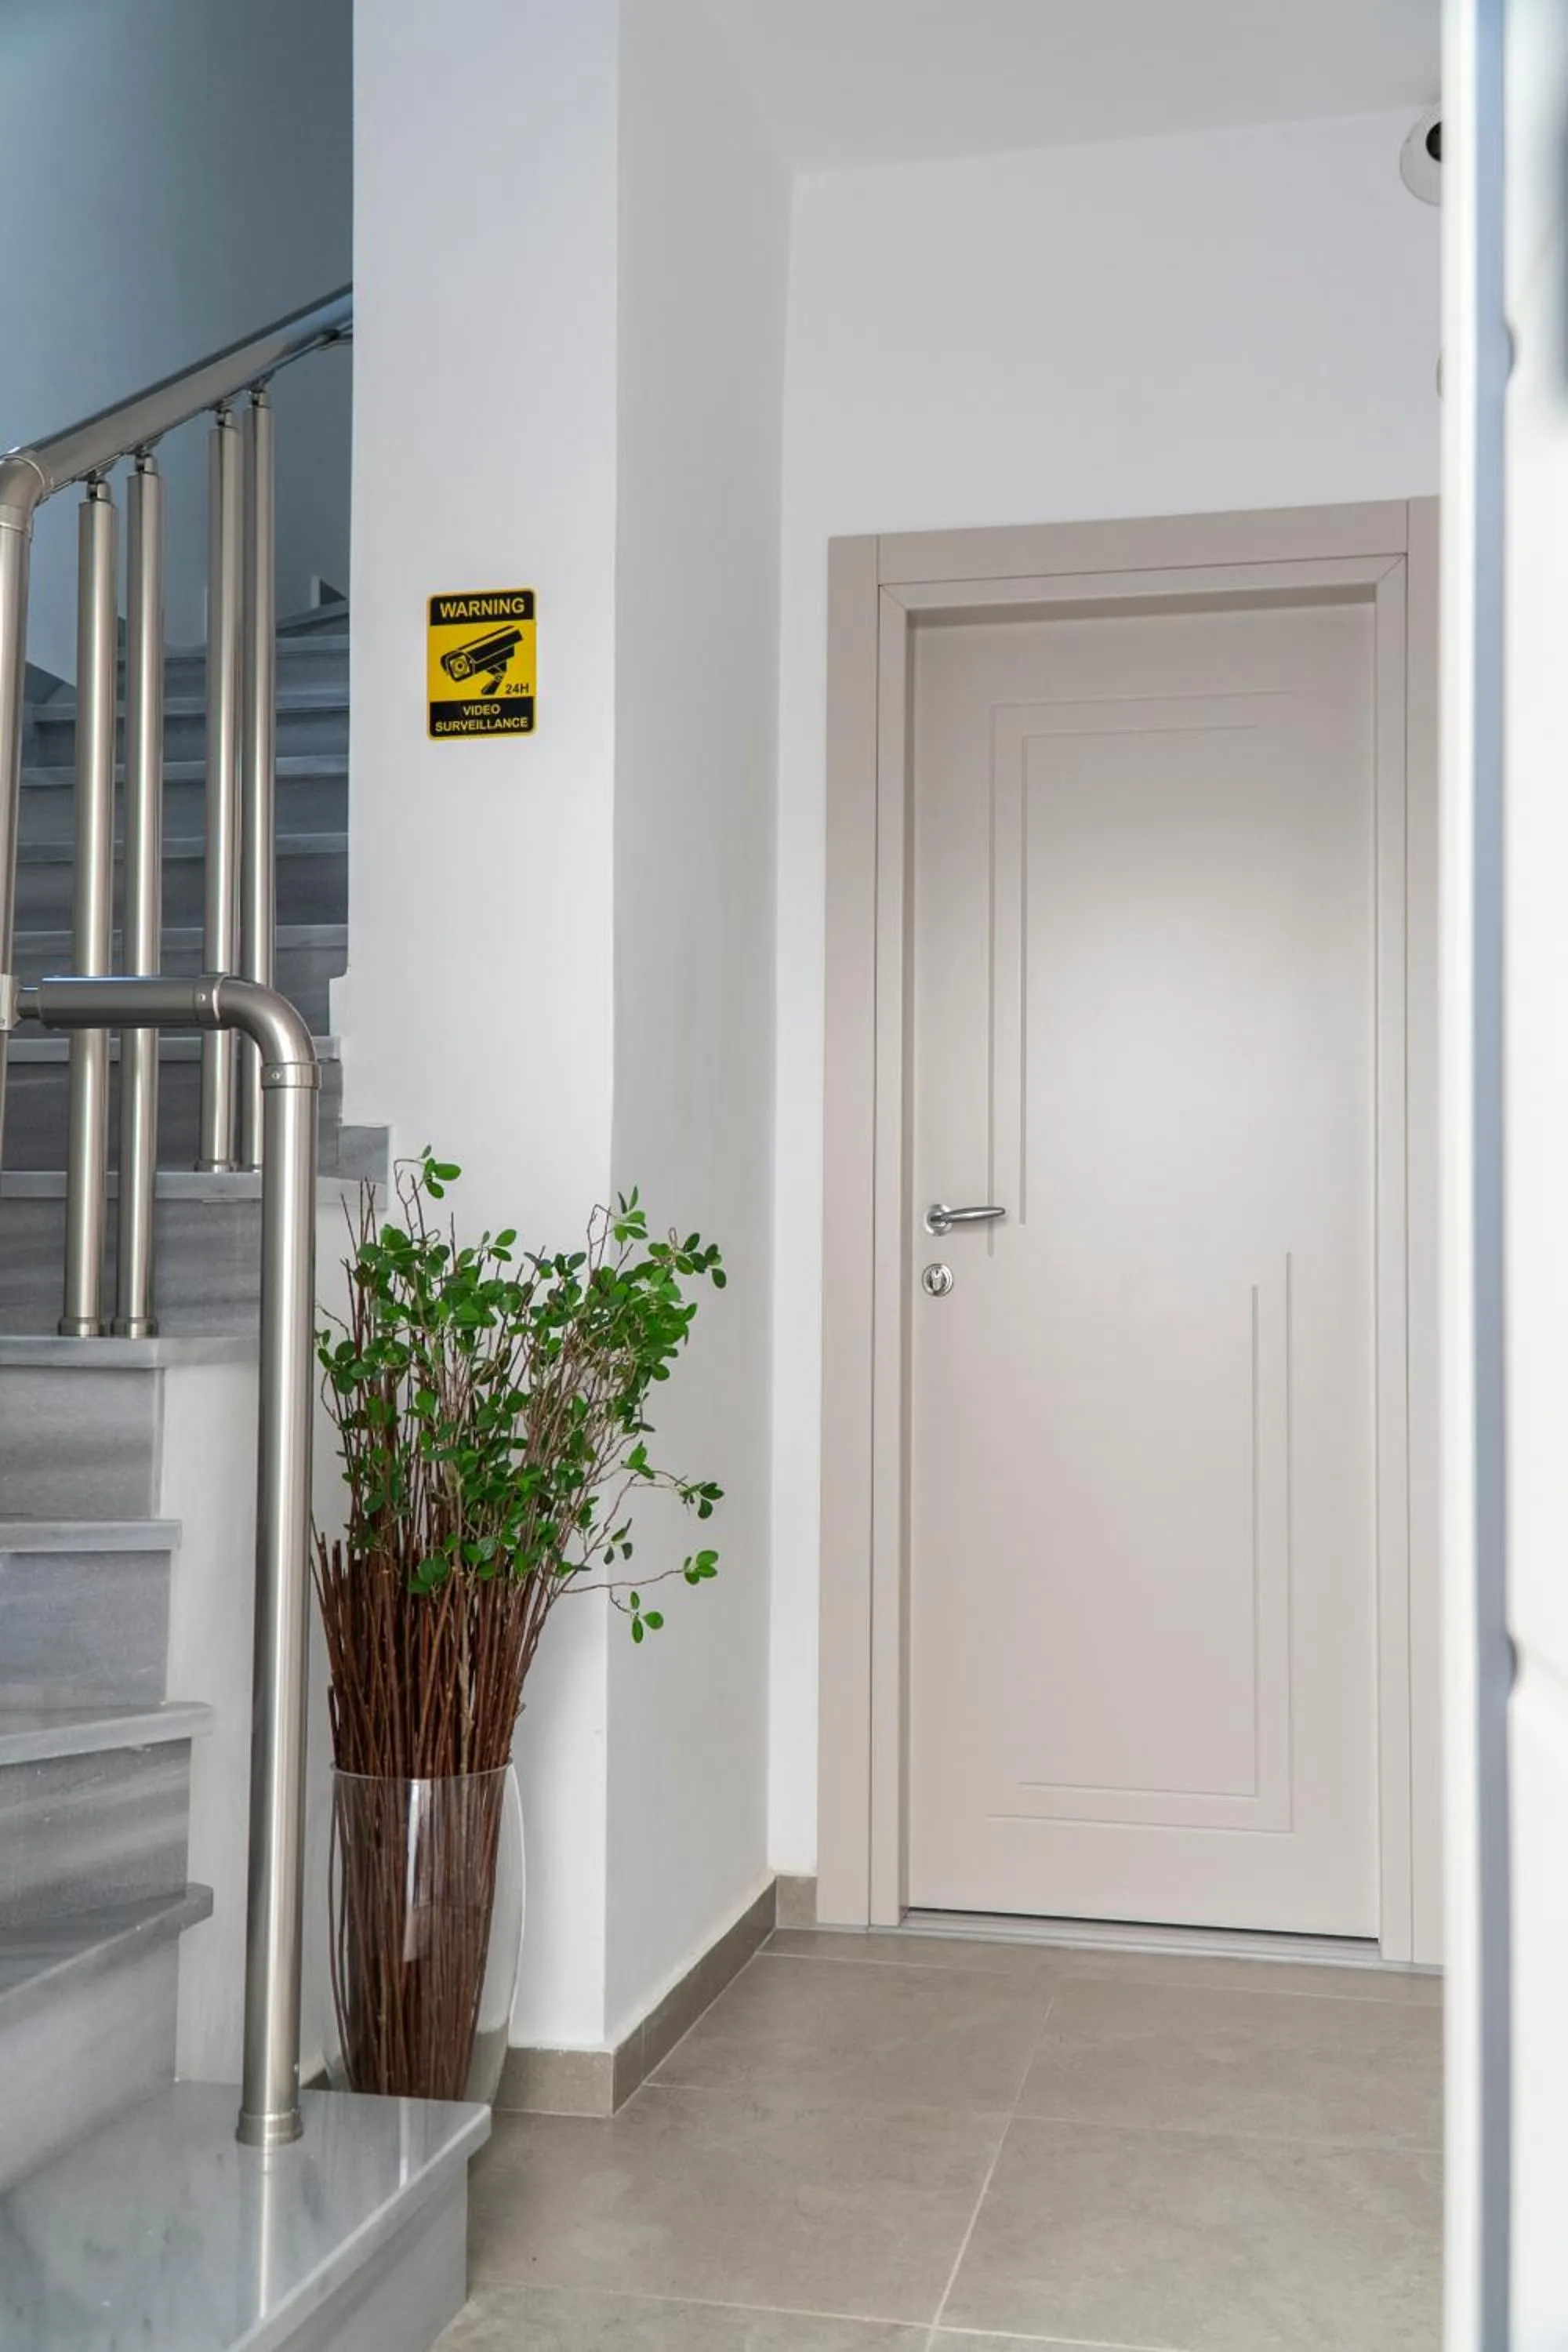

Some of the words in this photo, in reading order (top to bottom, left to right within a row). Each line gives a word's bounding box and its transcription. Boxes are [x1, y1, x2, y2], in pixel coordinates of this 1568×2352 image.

[440, 597, 524, 619] WARNING
[505, 683, 529, 695] 24H
[463, 703, 501, 716] VIDEO
[435, 717, 528, 731] SURVEILLANCE
